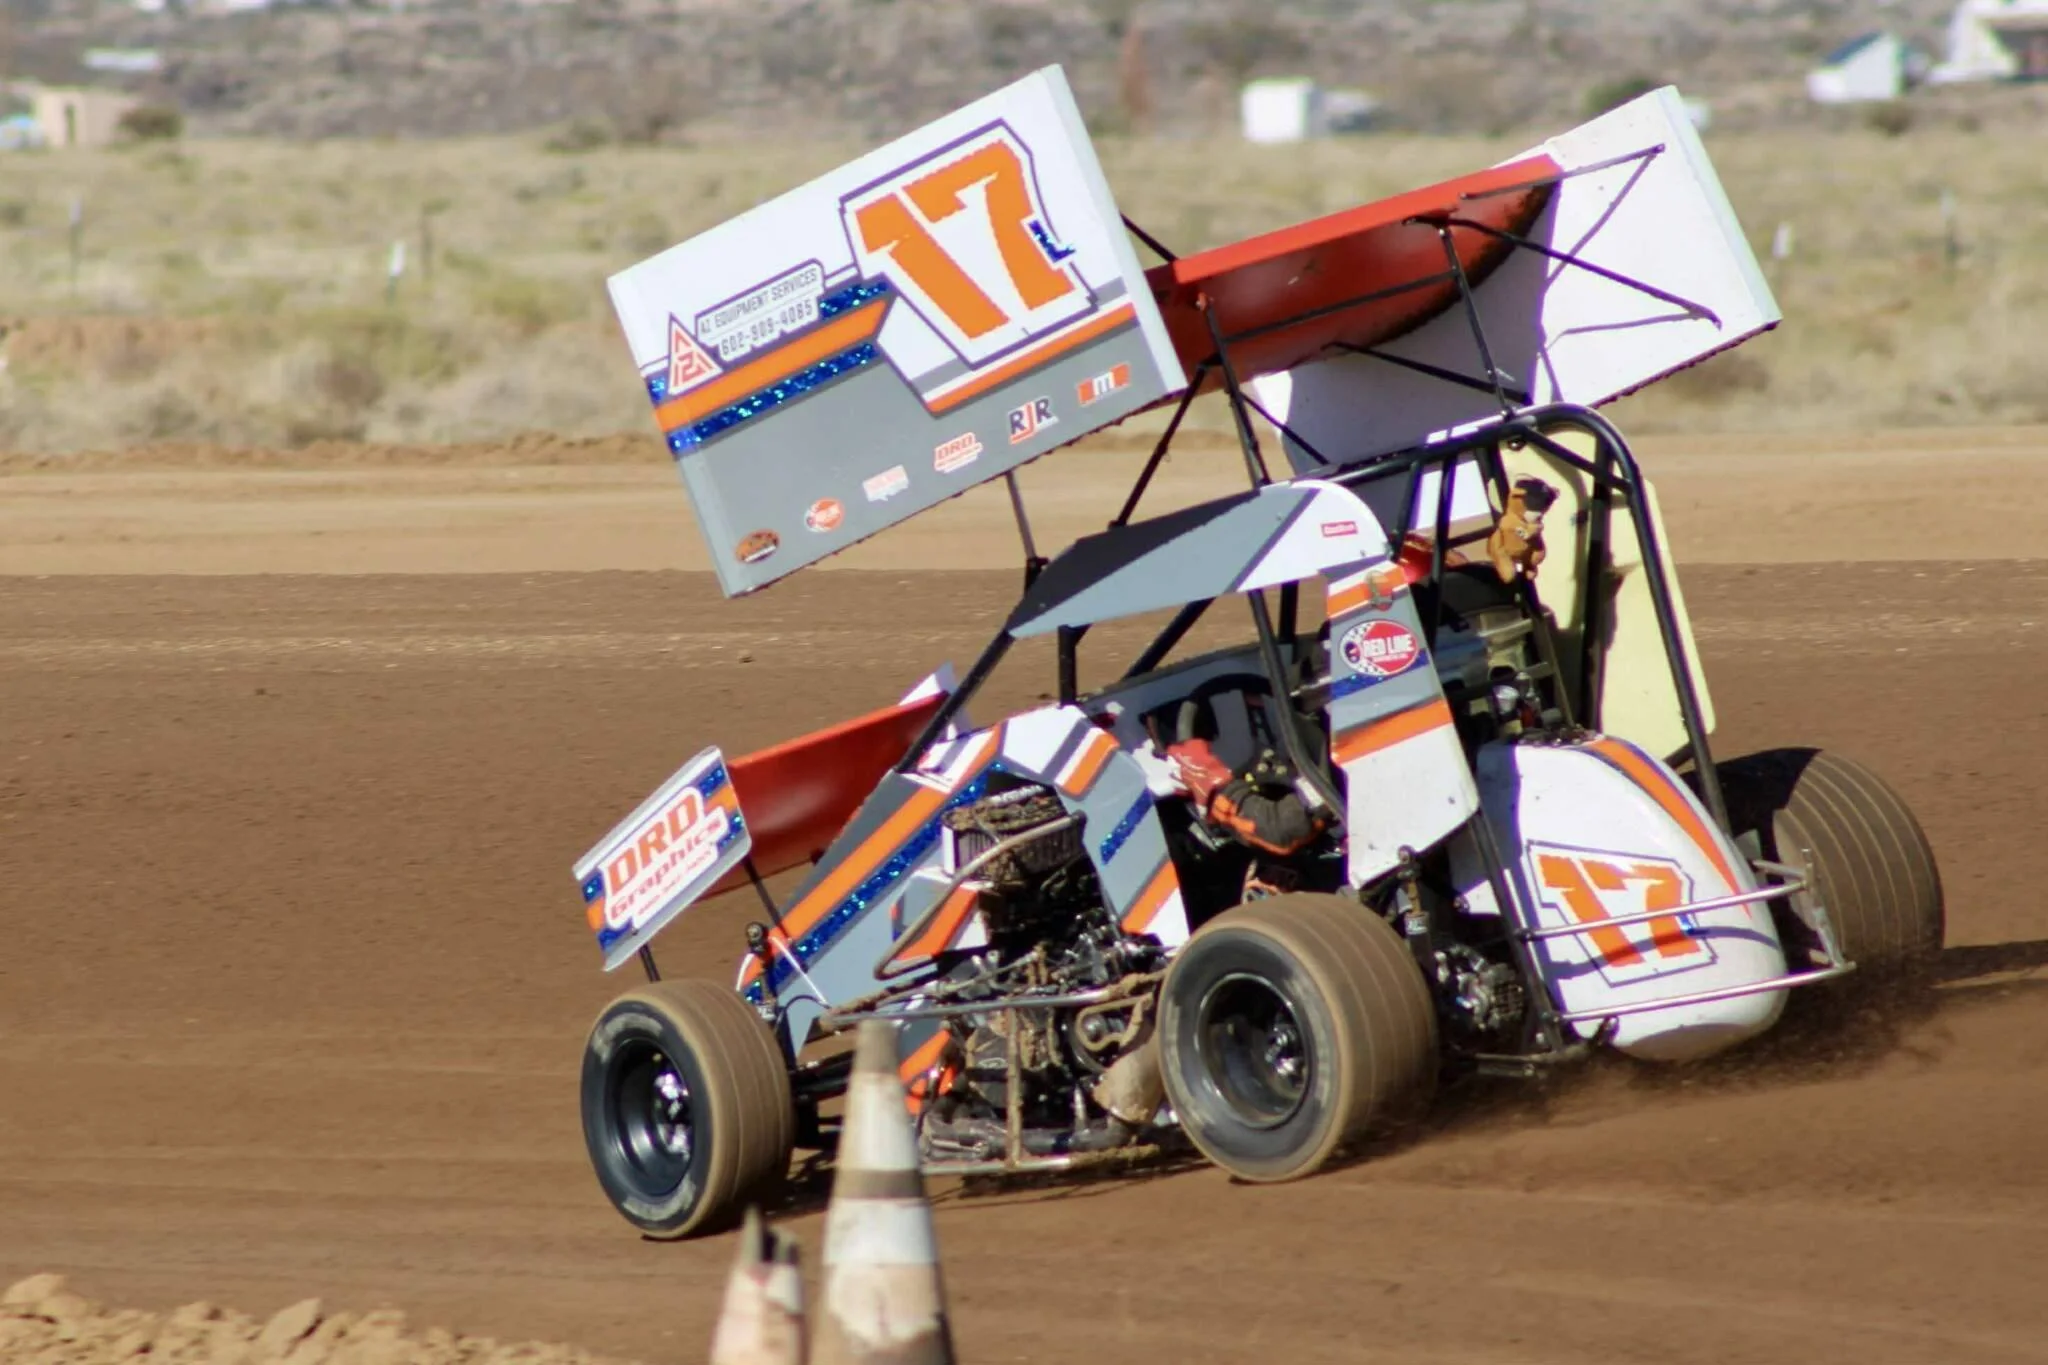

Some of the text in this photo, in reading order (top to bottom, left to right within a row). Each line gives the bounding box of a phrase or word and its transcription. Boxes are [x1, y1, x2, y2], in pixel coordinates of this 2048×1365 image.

[715, 291, 768, 328] EQUIPMENT
[771, 268, 817, 300] SERVICES
[1008, 397, 1053, 444] RJR
[1362, 636, 1387, 658] RED
[1387, 633, 1415, 655] LINE
[608, 794, 698, 896] DRD
[609, 817, 722, 921] Graphics
